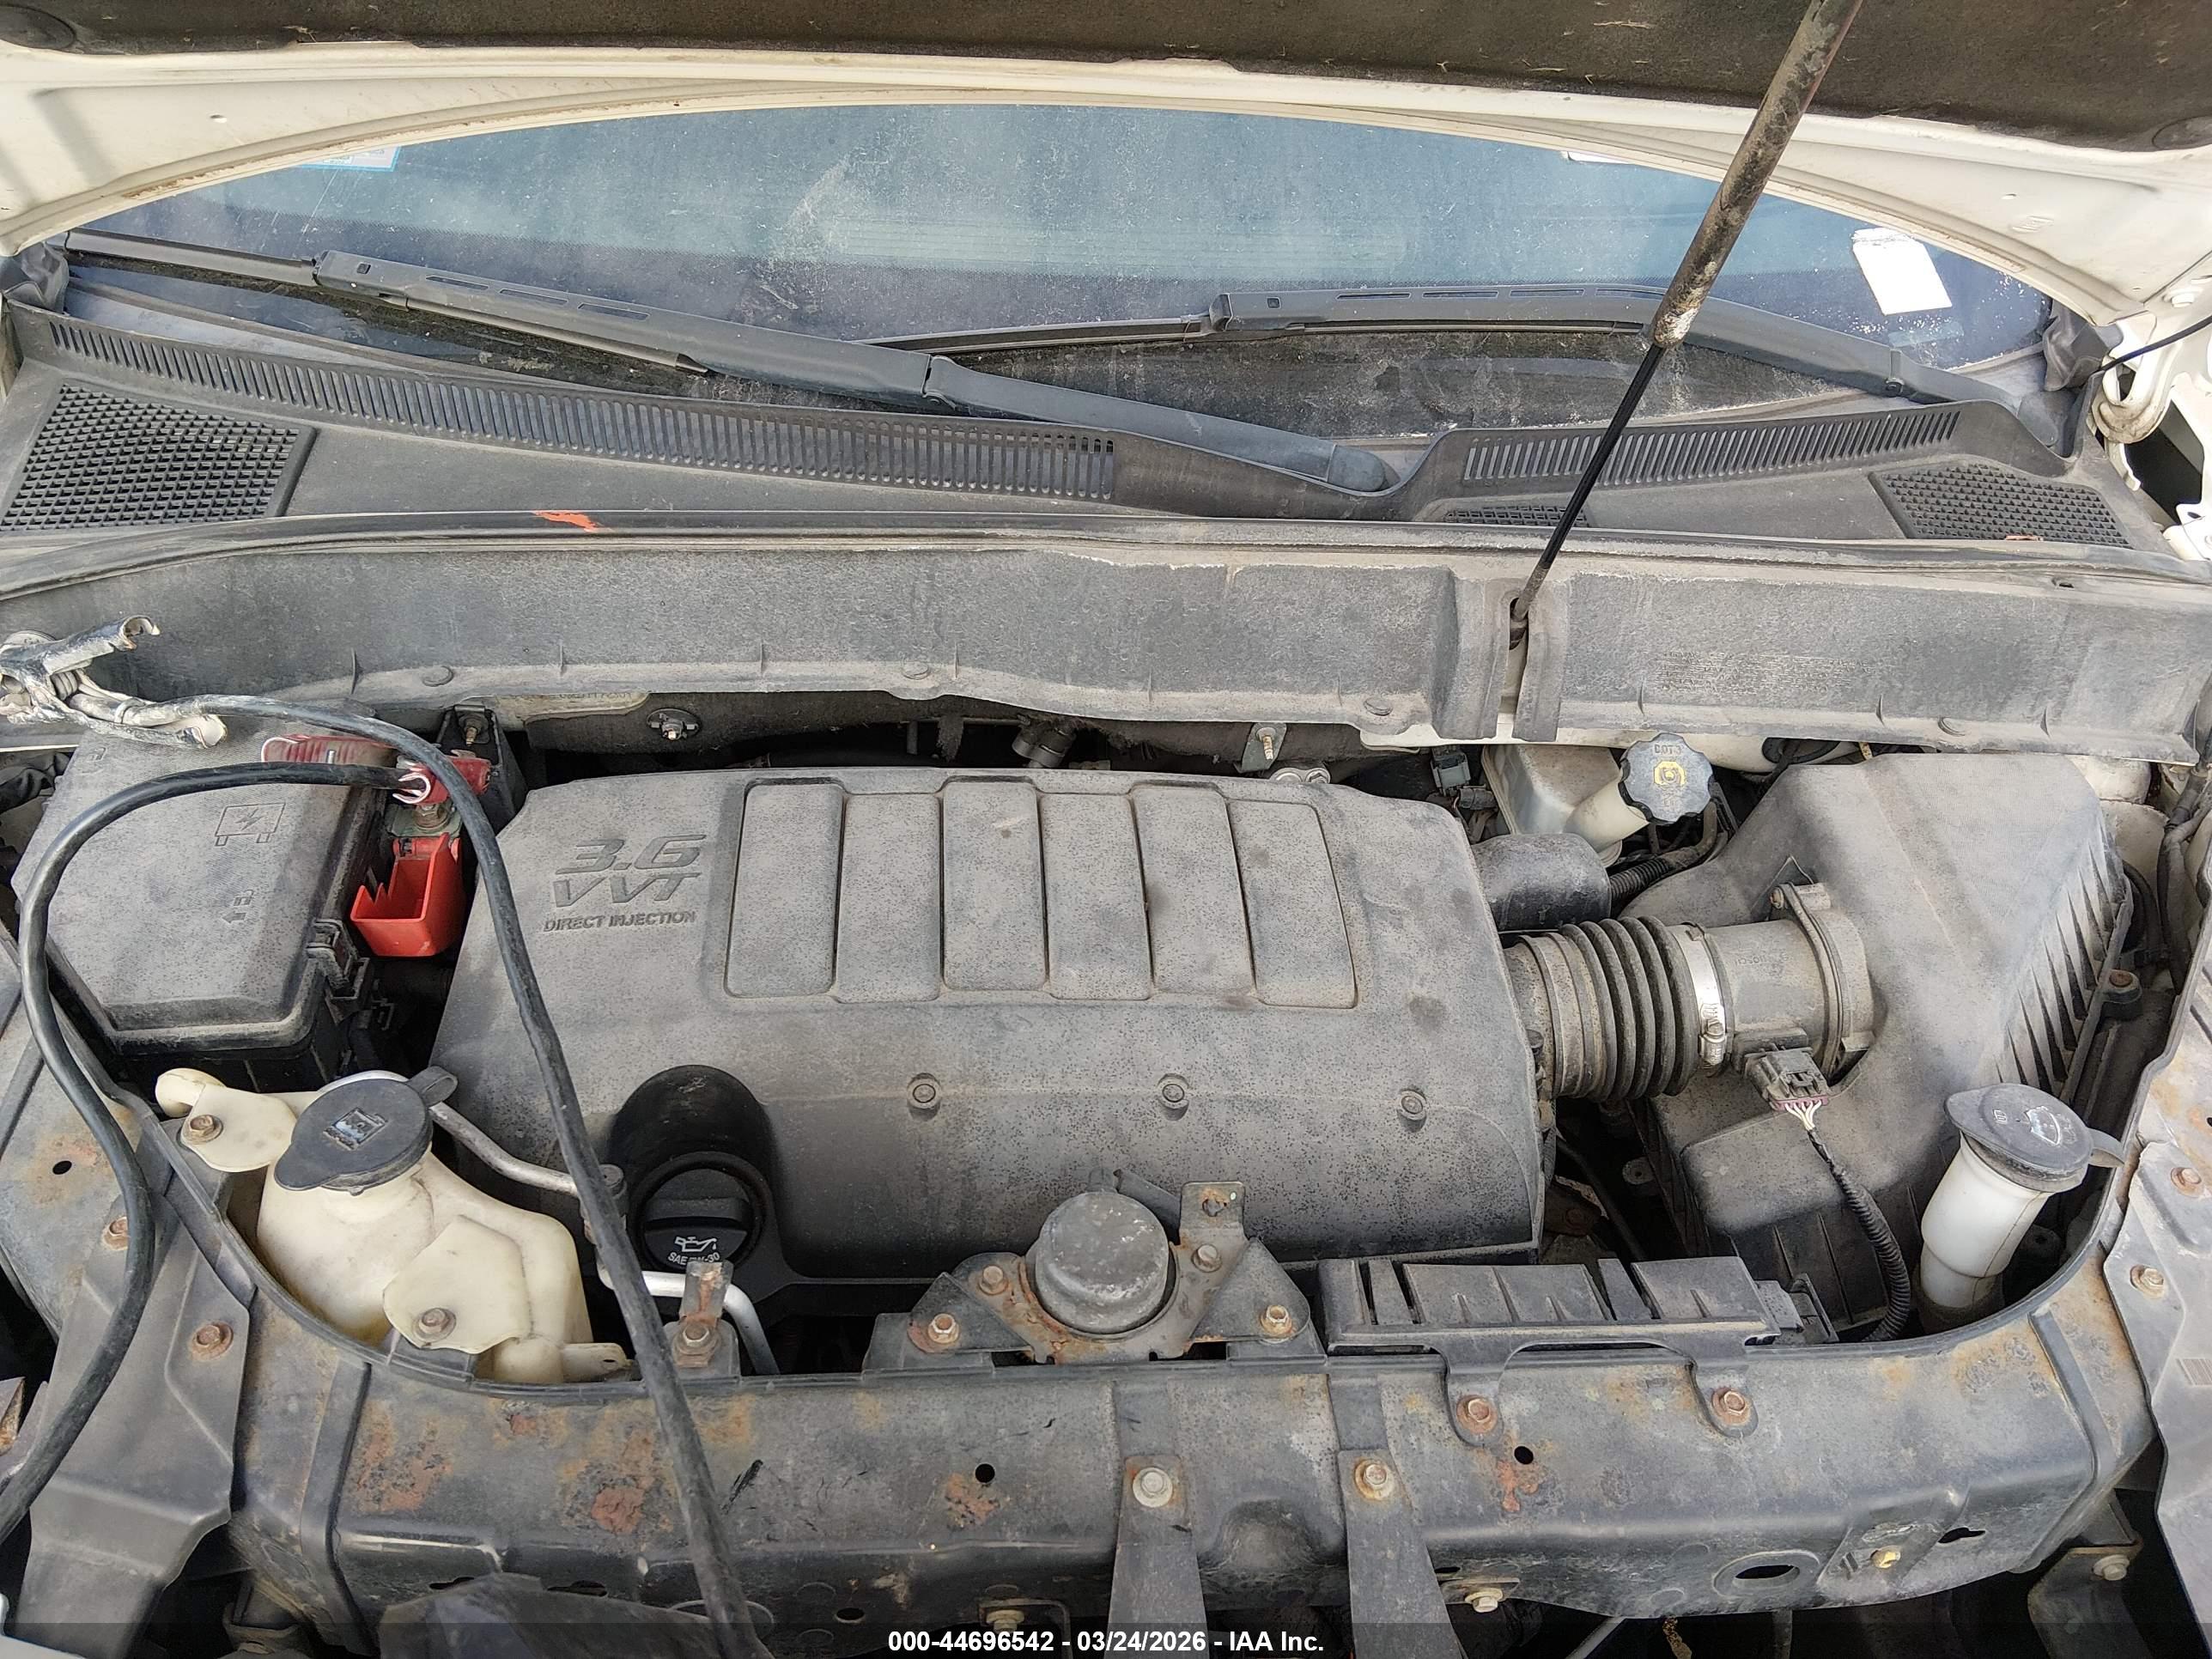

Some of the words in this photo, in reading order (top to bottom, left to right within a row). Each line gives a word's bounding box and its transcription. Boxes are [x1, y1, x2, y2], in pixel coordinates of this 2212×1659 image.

[556, 835, 707, 874] 3.6
[553, 872, 702, 908] VVT
[544, 915, 605, 932] DIRECT
[608, 910, 696, 927] INJECTION
[668, 1252, 688, 1266] SAE
